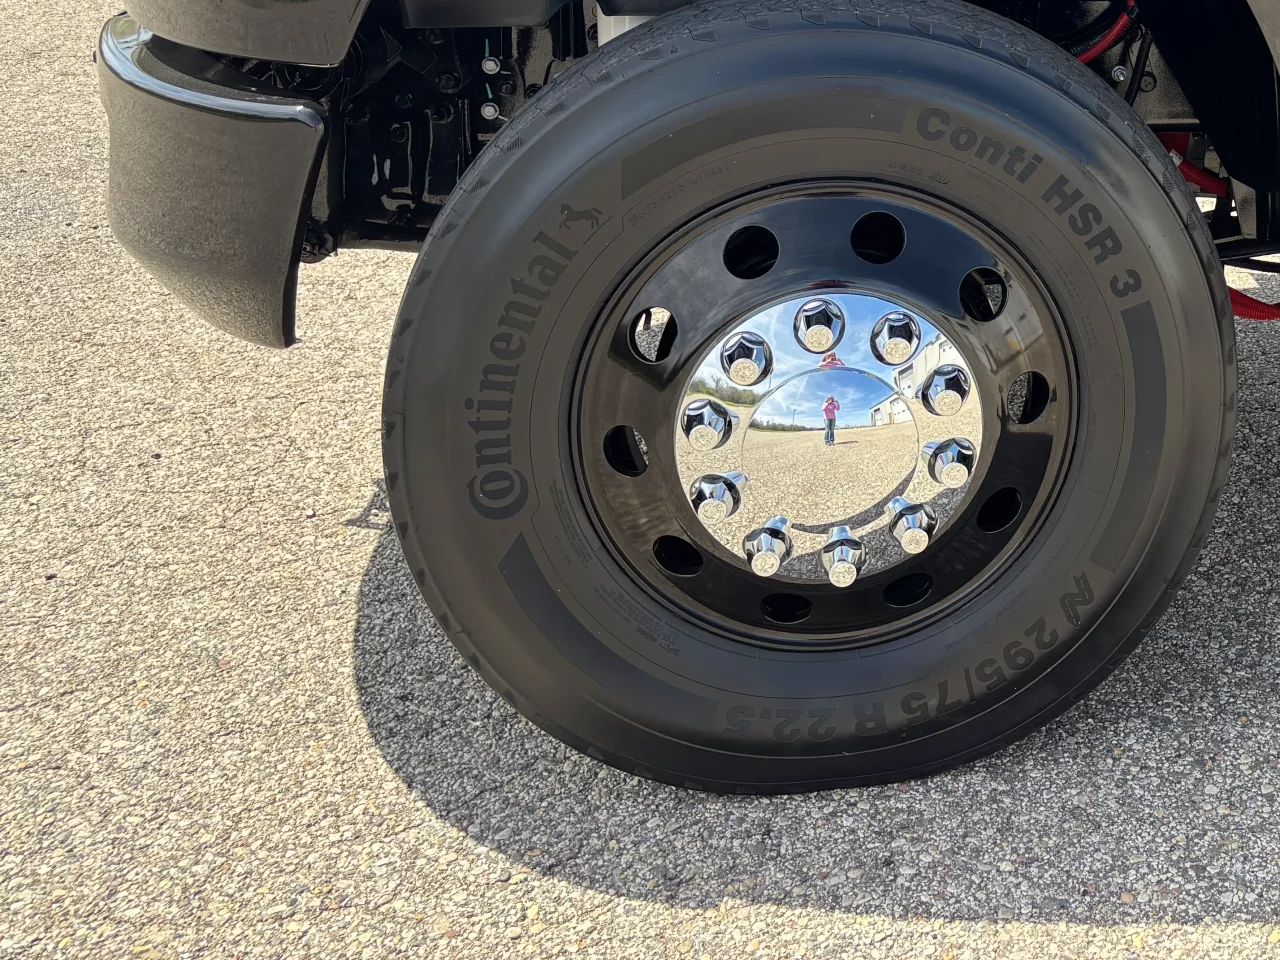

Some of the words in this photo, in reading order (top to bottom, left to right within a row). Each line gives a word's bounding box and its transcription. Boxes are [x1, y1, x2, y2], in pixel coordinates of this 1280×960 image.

[916, 107, 1045, 184] Conti
[1040, 173, 1123, 266] HSR
[1109, 268, 1142, 299] 3
[464, 230, 579, 521] Continental
[723, 703, 837, 742] 22.5
[853, 700, 888, 737] R
[901, 615, 1059, 726] 295/75
